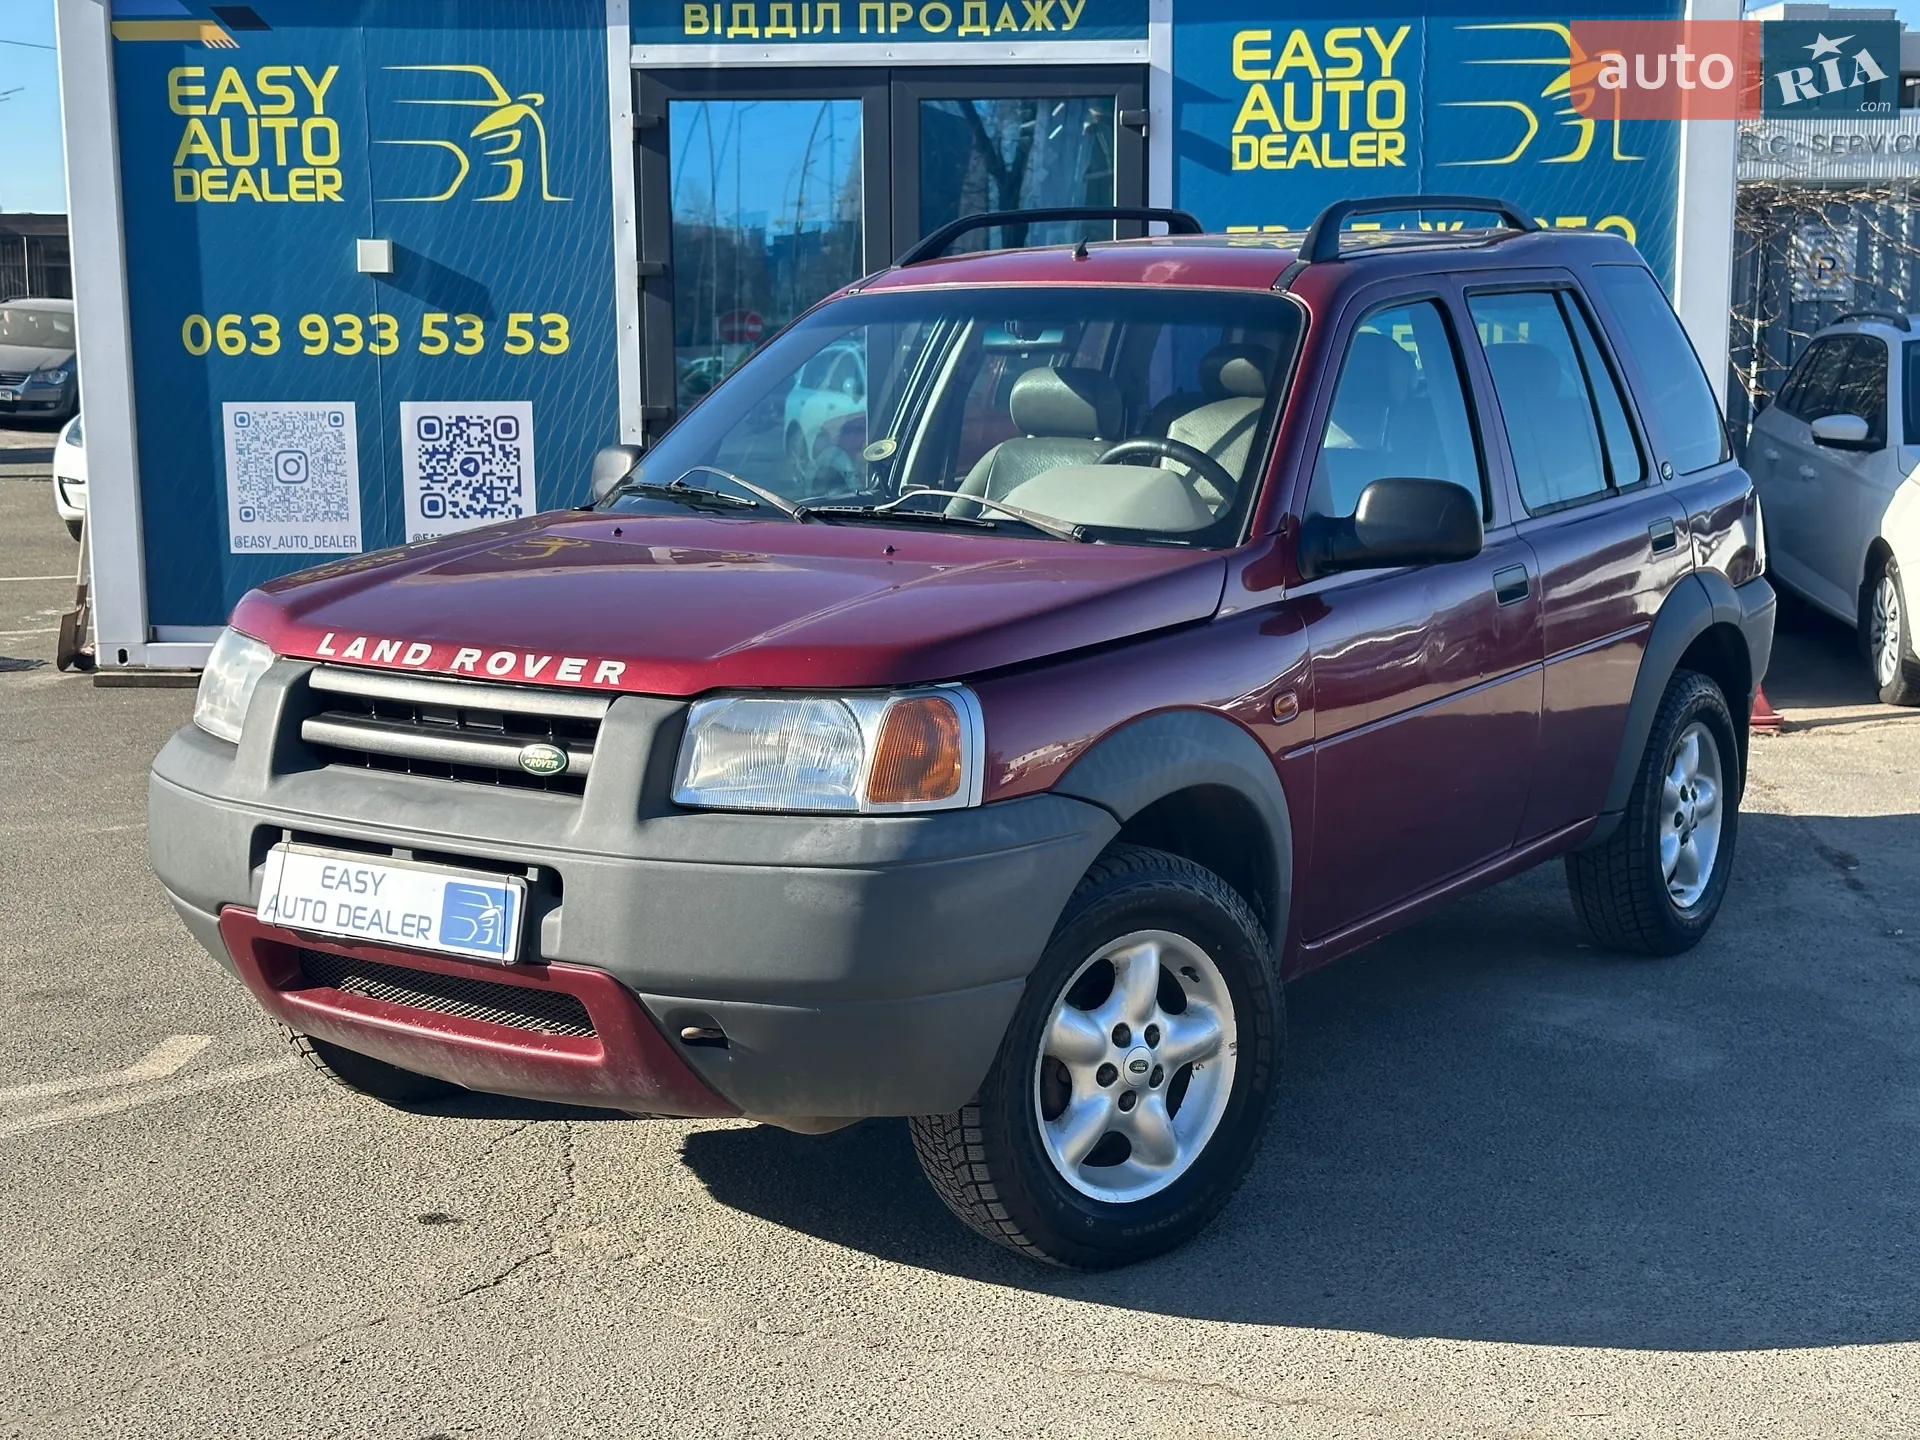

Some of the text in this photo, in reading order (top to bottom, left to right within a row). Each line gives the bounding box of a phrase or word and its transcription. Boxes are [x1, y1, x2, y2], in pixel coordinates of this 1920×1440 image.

[684, 1, 1085, 38] ВІДДІЛ ПРОДАЖУ
[1232, 26, 1410, 80] EASY
[168, 66, 340, 116] EASY
[1233, 80, 1406, 133] AUTO
[173, 117, 340, 167] AUTO
[1232, 131, 1406, 170] DEALER
[174, 167, 344, 202] DEALER
[182, 312, 570, 356] 063 933 53 53
[234, 535, 357, 551] @EASY_AUTO_DEALER
[316, 632, 627, 685] LAND ROVER
[321, 865, 387, 896] EASY
[264, 894, 433, 941] AUTO DEALER
